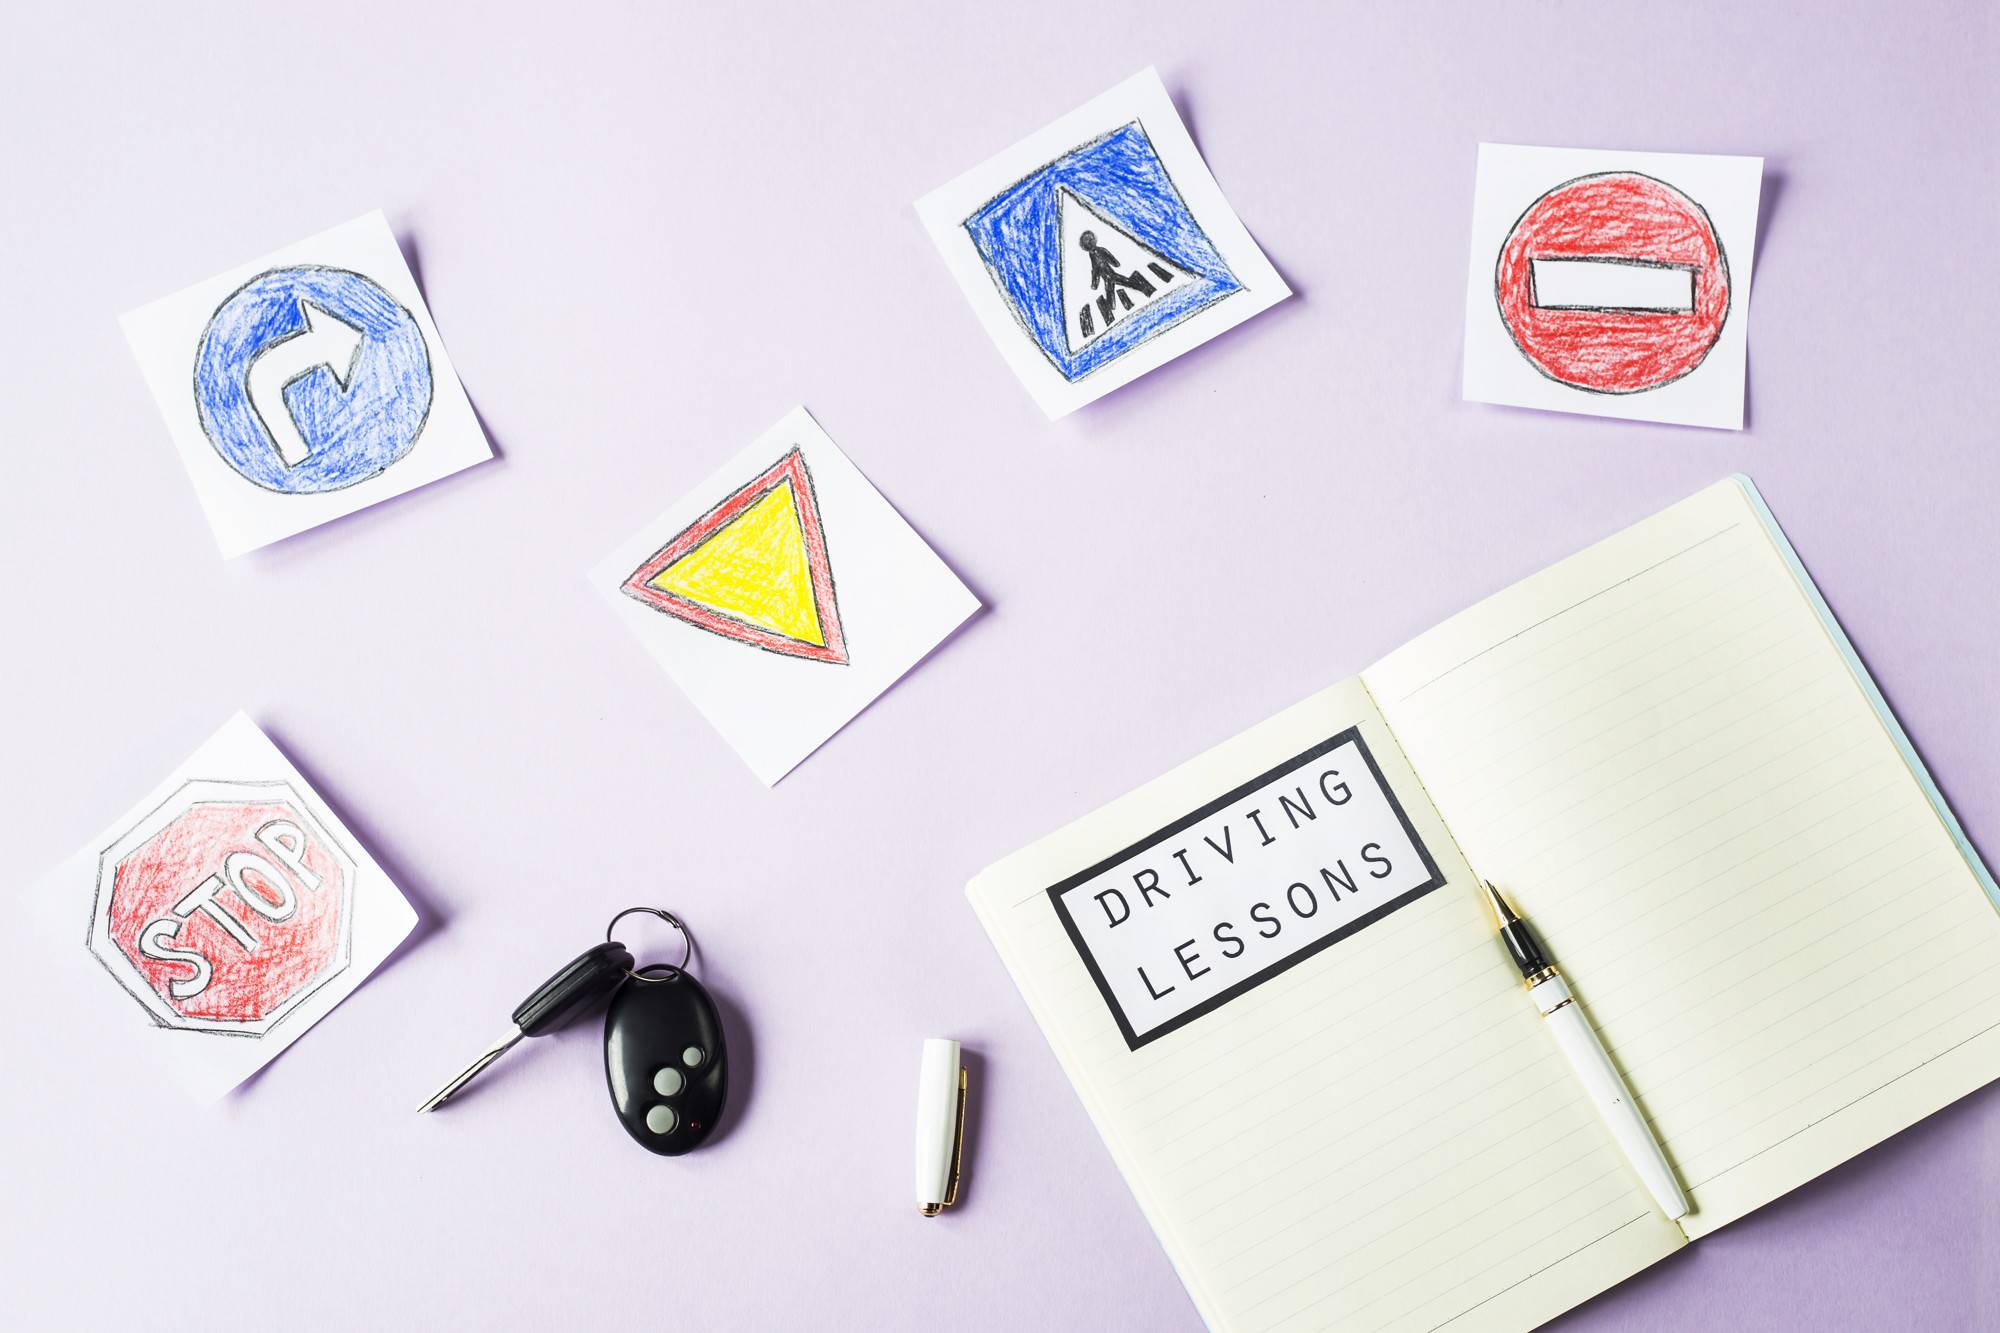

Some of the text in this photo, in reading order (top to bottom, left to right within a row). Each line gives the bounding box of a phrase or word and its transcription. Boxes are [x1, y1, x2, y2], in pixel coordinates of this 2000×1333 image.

[138, 818, 323, 1001] STOP
[1094, 769, 1353, 929] DRIVING
[1137, 842, 1393, 1001] LESSONS
